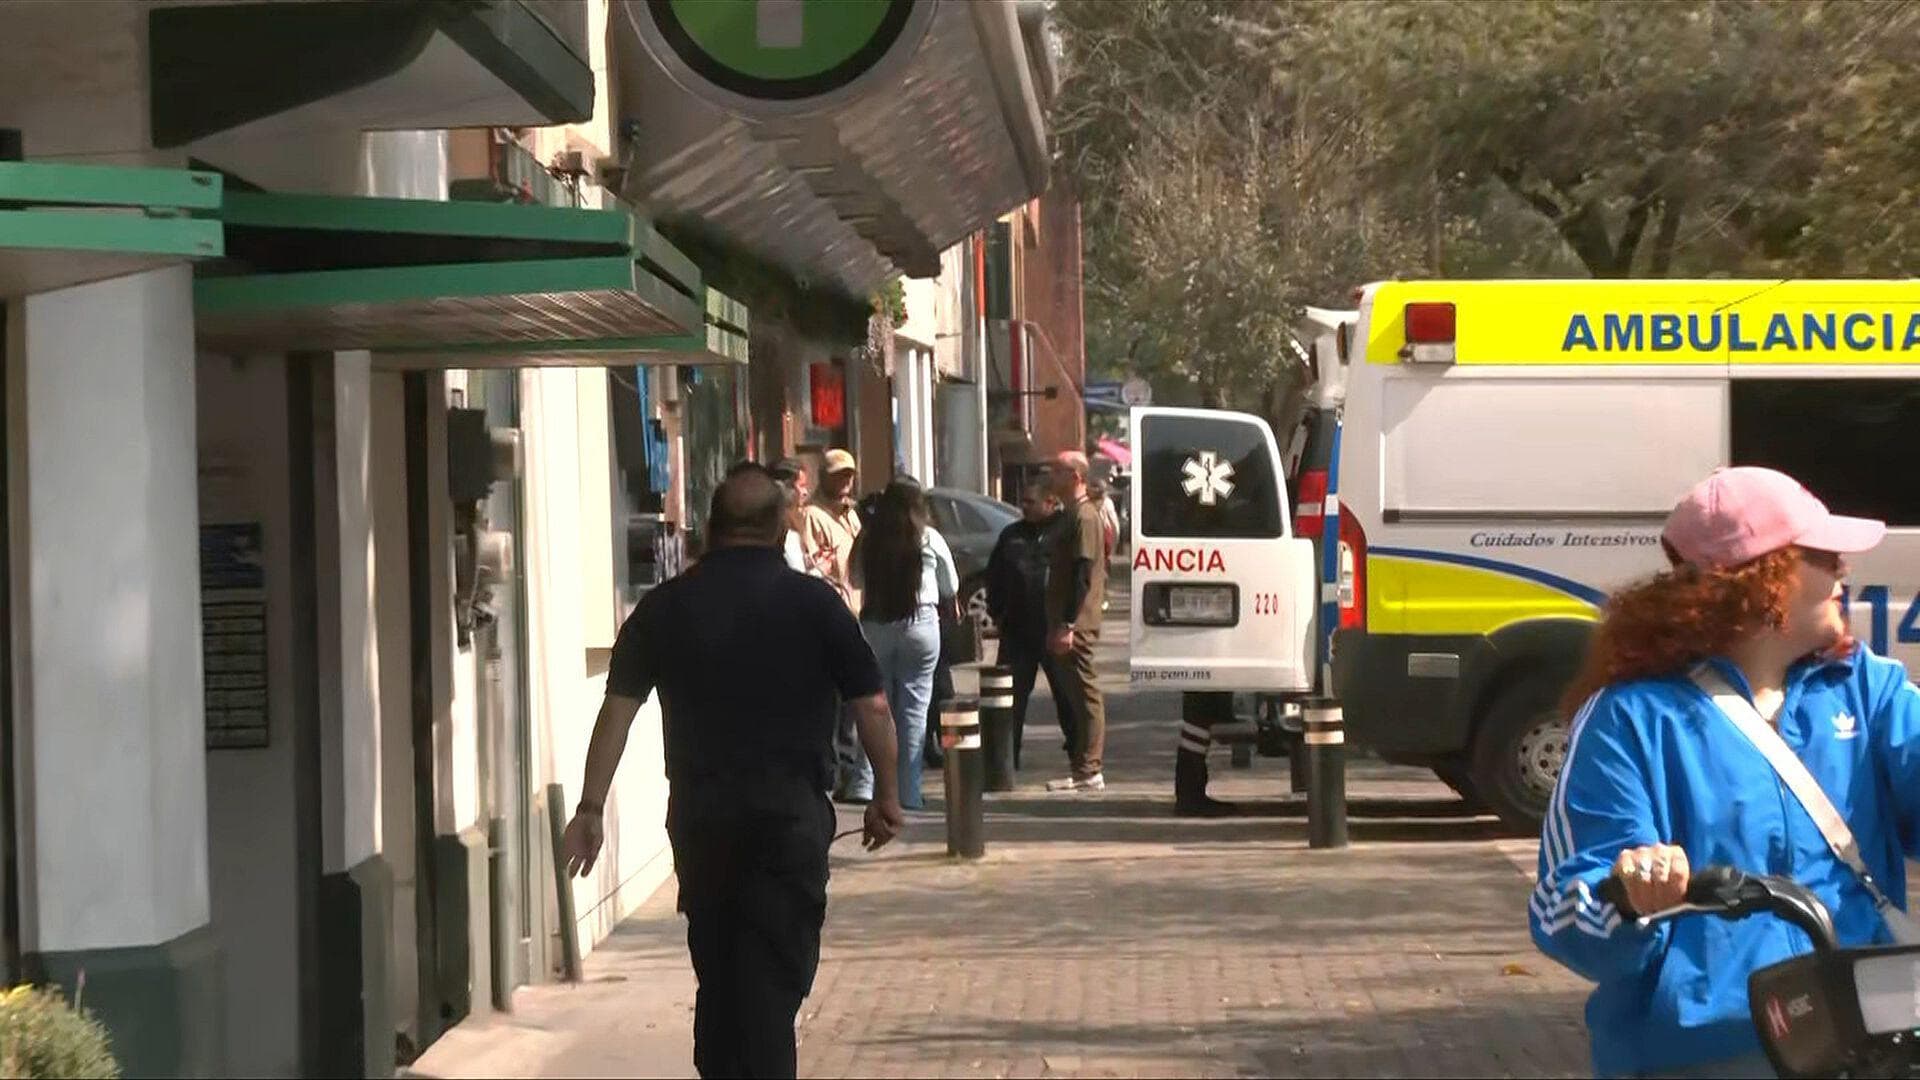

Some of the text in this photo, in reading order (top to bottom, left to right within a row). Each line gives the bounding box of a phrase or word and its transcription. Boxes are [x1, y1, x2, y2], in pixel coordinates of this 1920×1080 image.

[1561, 313, 1920, 352] AMBULANCIA
[1470, 532, 1657, 547] Cuidados Intensivos
[1133, 548, 1225, 572] ANCIA
[1255, 593, 1278, 615] 220
